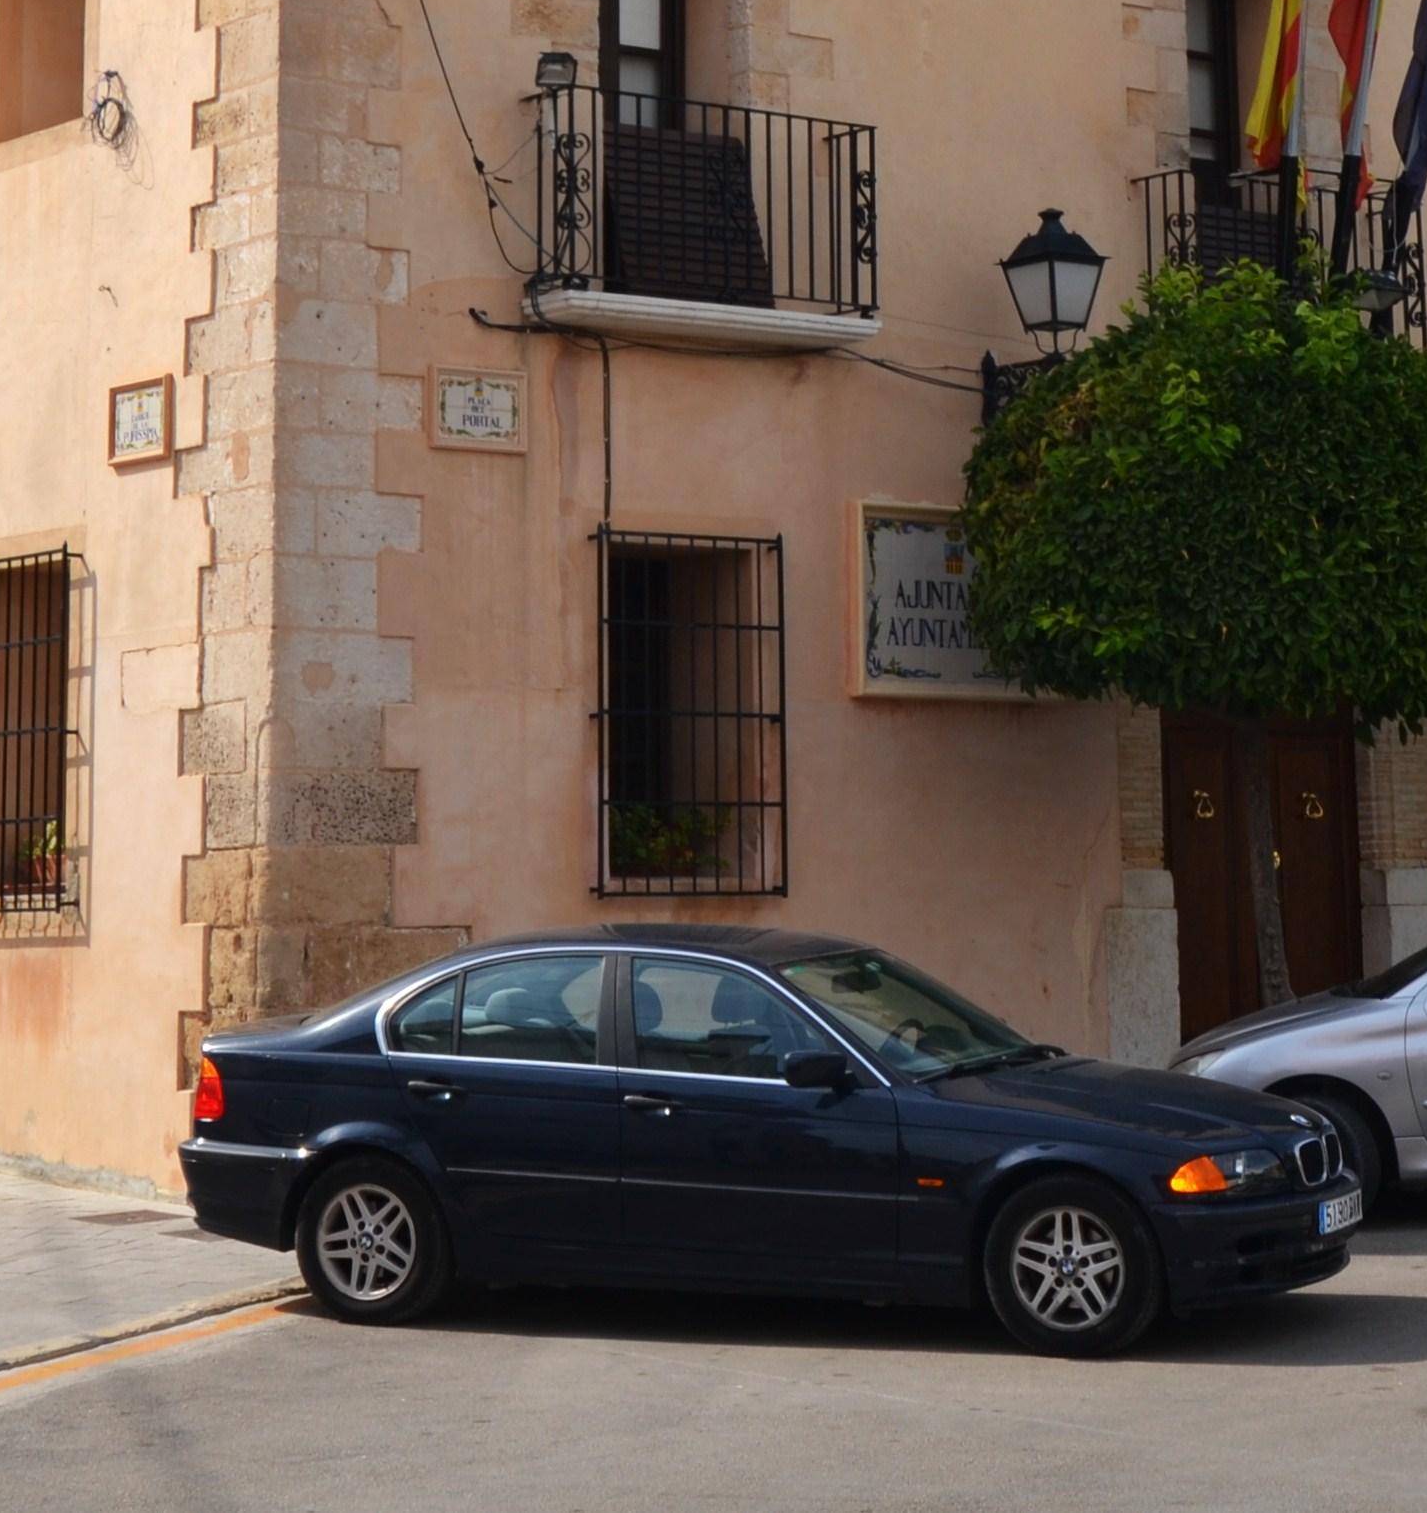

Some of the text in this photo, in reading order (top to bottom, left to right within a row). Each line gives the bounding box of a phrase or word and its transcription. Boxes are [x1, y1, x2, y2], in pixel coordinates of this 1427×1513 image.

[462, 414, 503, 429] PORTAL
[894, 579, 973, 611] AJUNTA
[886, 616, 976, 650] AYUNTAM
